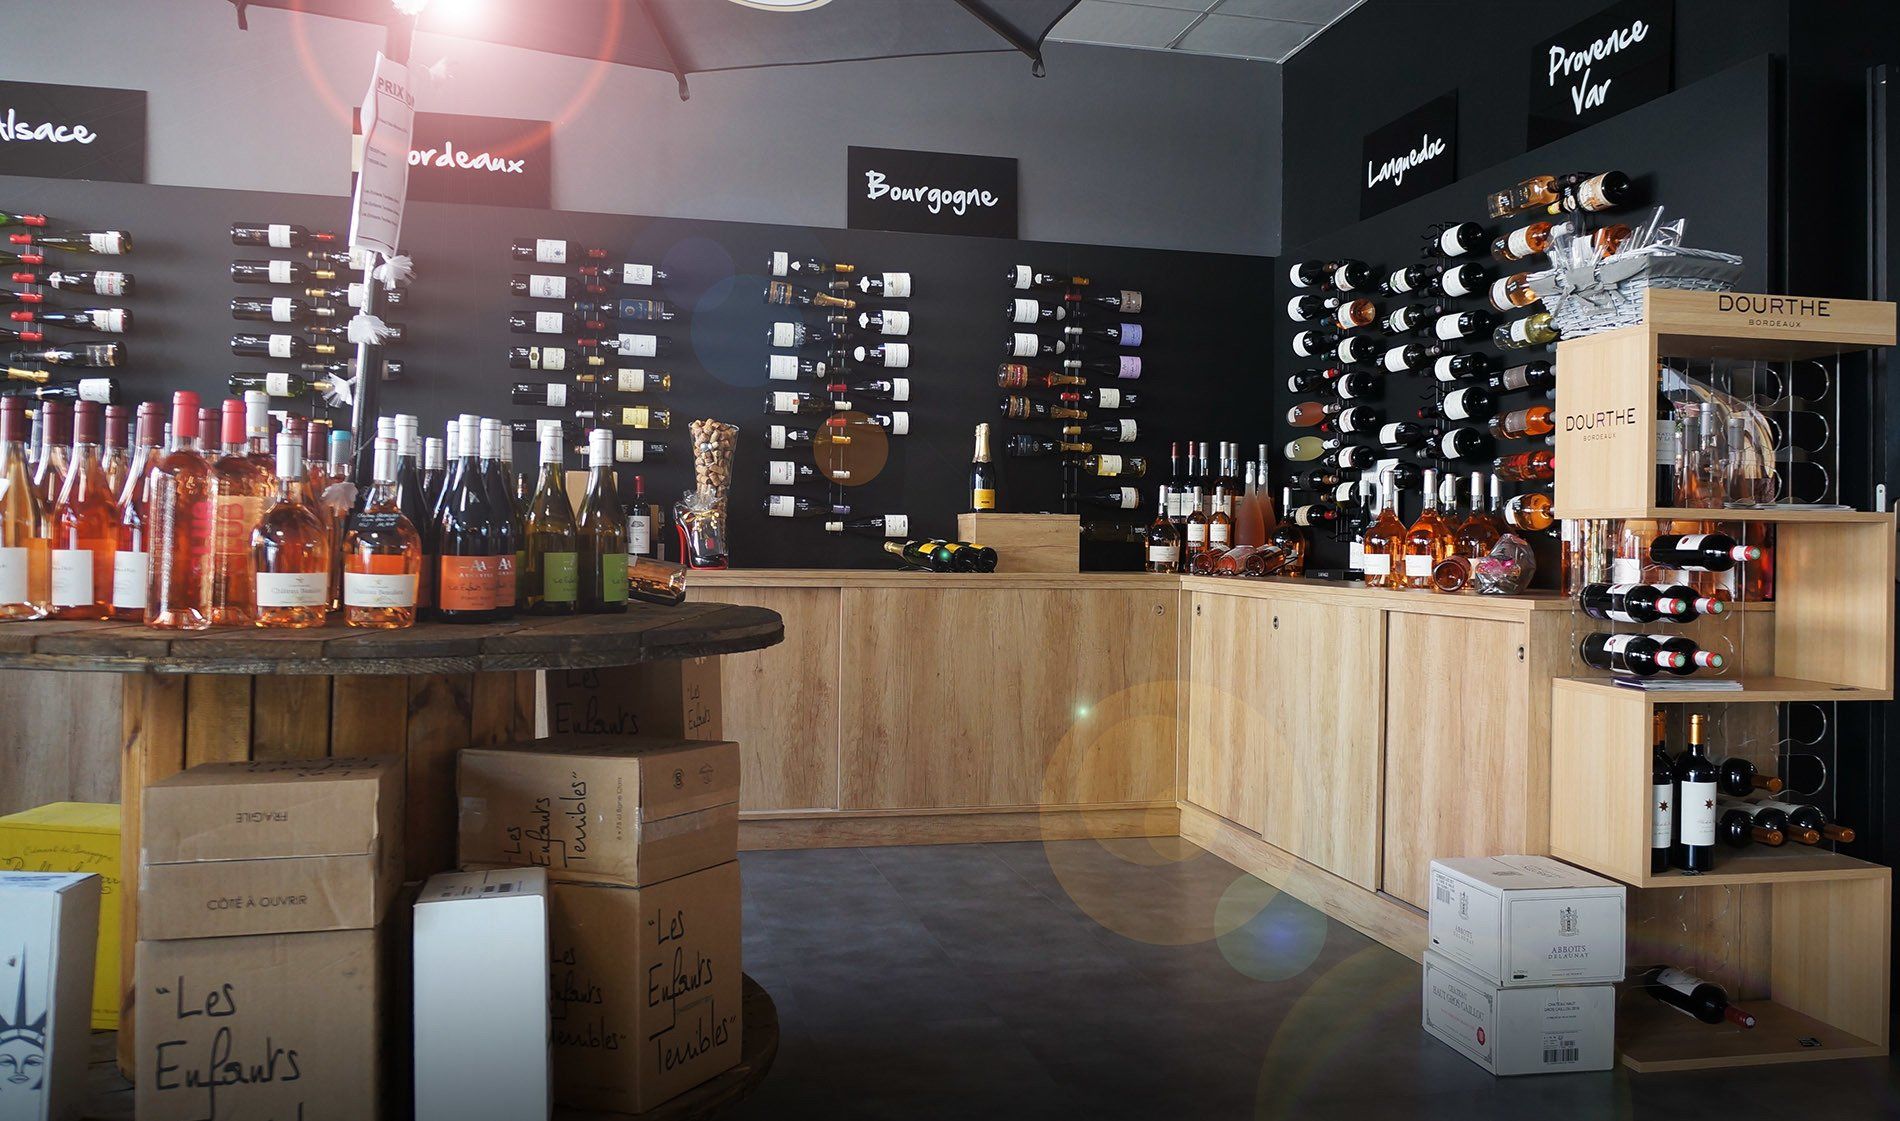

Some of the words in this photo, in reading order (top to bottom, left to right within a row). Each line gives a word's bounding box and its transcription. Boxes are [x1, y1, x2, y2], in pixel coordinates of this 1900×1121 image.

[1548, 18, 1649, 87] Provence
[377, 76, 404, 100] PRIX
[1571, 68, 1612, 116] Var
[408, 140, 526, 174] ordeaux
[1366, 132, 1447, 190] Languedoc
[865, 169, 999, 217] Bourgogne
[1718, 294, 1831, 317] DOURTHE
[1748, 319, 1801, 328] BORDEAUX
[1565, 407, 1636, 432] DOURTHE
[1583, 432, 1617, 442] BORDEAUX
[236, 812, 288, 824] FRAGILE
[258, 894, 308, 908] OUVRIR
[648, 946, 714, 1026] Enfants
[155, 1026, 301, 1118] Enfants
